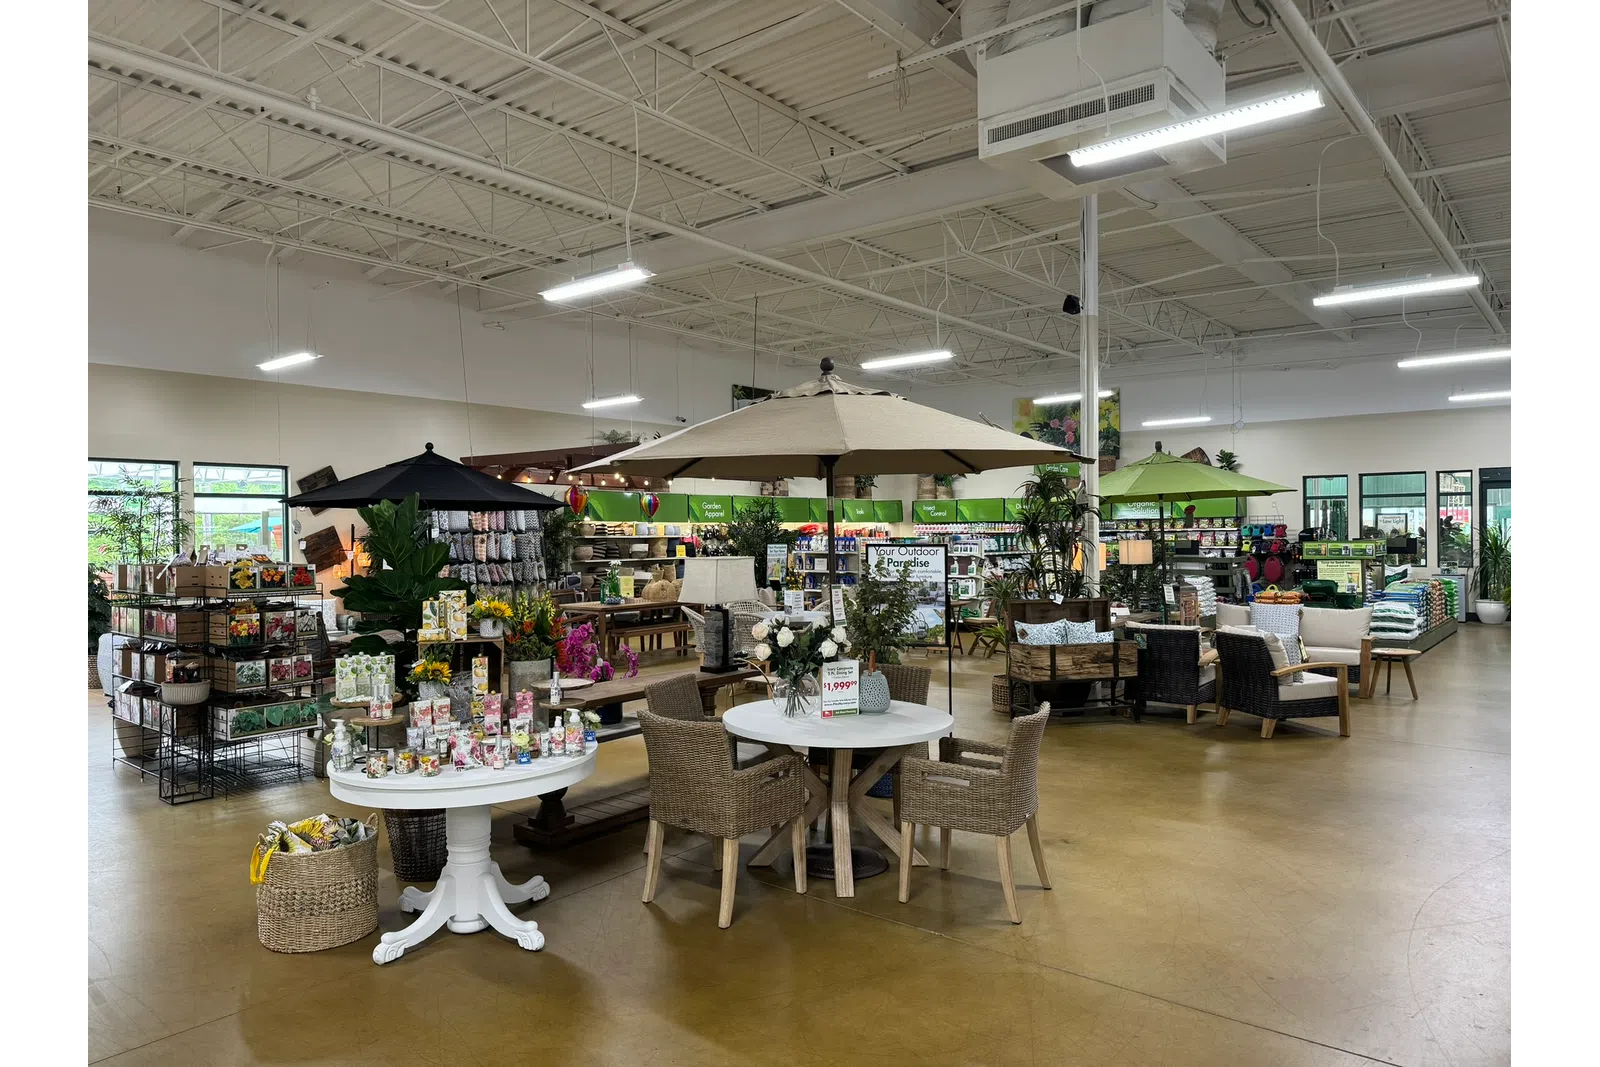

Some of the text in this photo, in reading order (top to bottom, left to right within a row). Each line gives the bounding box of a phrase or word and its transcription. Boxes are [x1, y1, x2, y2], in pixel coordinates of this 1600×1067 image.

[702, 502, 721, 510] Garden
[705, 510, 724, 518] Apparel
[874, 546, 939, 556] Your Outdoor
[887, 557, 930, 567] Pardise
